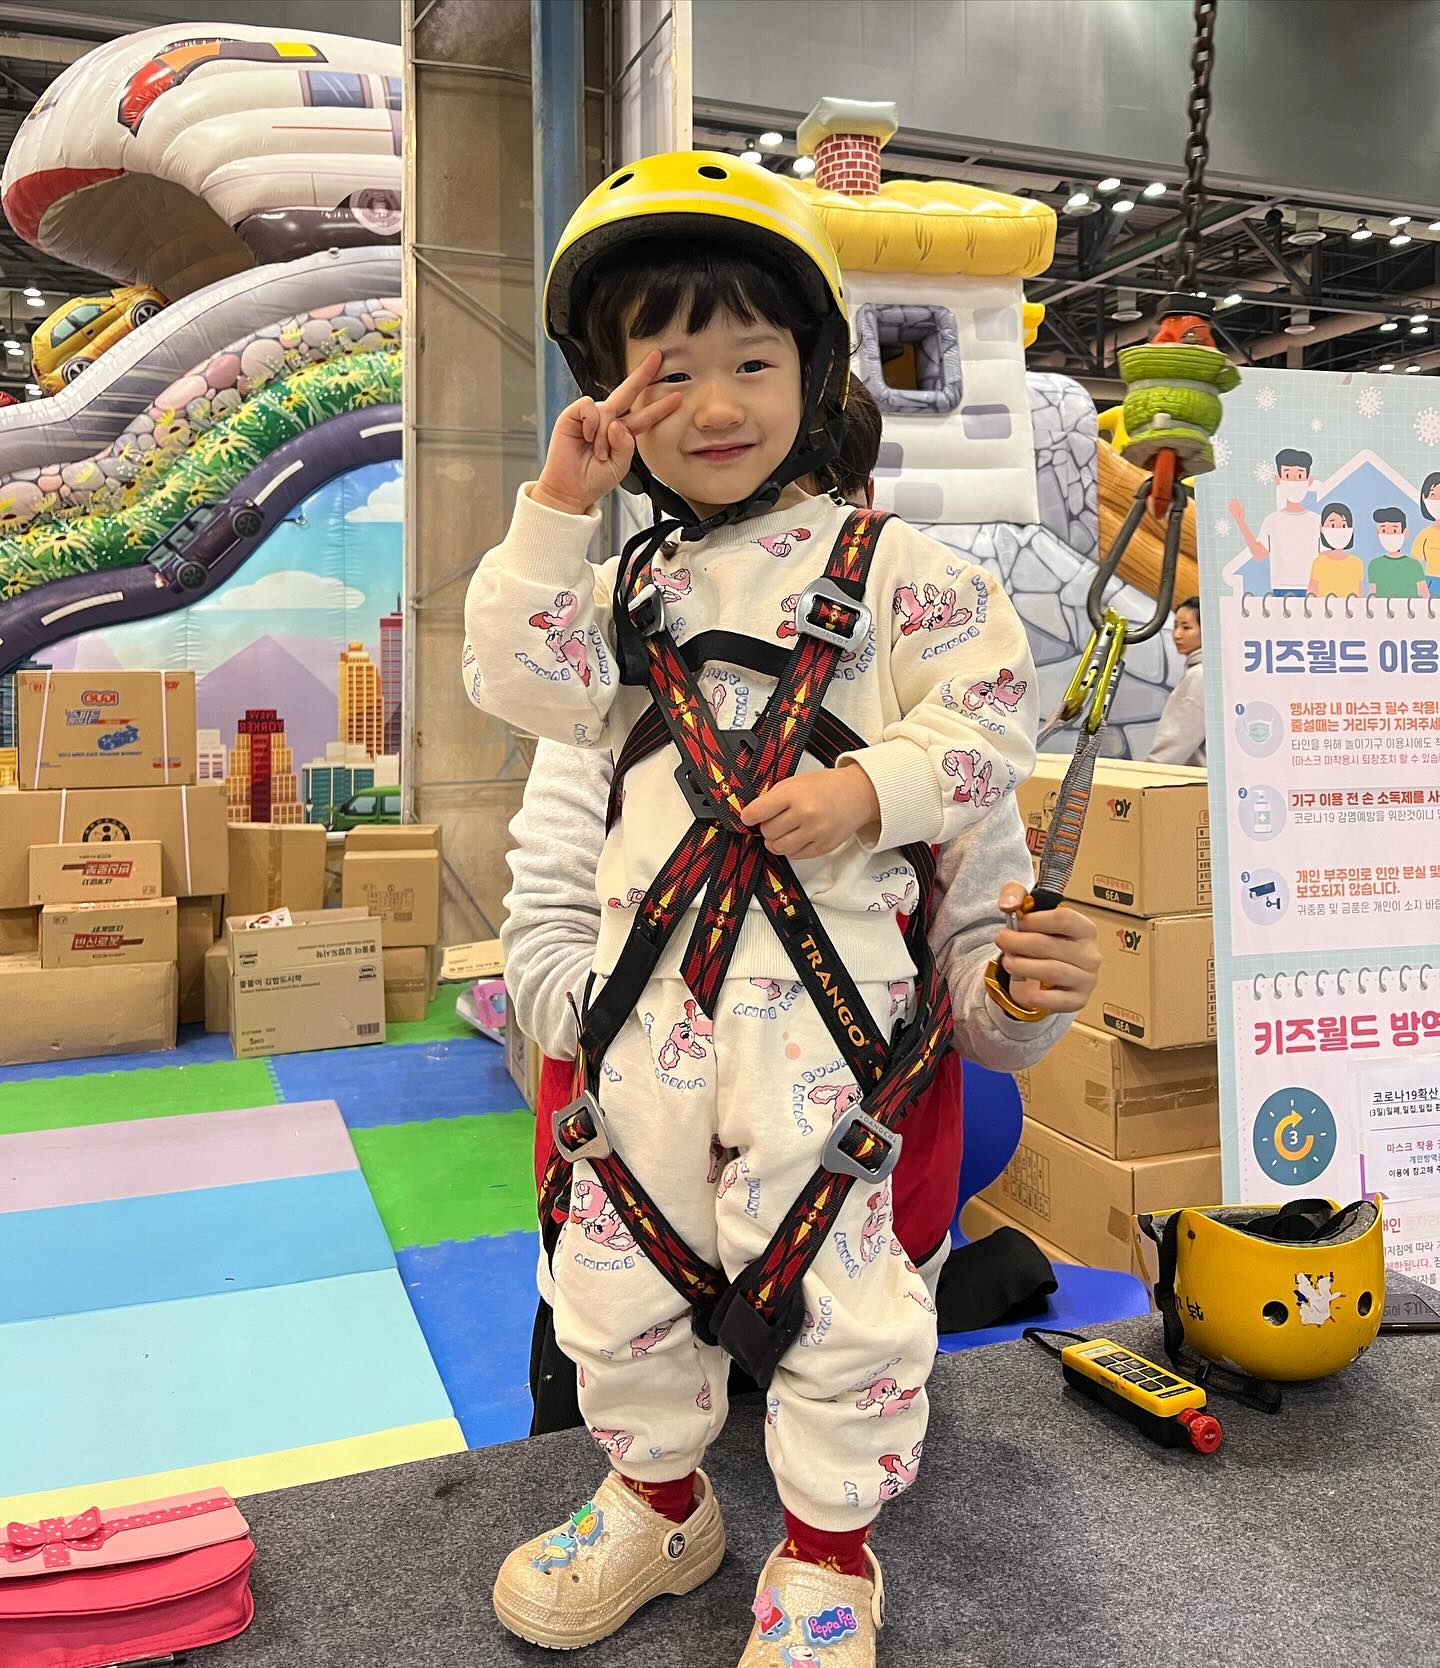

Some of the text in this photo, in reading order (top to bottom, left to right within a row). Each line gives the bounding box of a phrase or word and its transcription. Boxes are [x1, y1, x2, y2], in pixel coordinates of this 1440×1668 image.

[971, 575, 988, 623] LOVELY
[922, 626, 980, 660] BUNNY
[587, 624, 611, 686] BUNNY
[1244, 639, 1439, 674] 키즈월드 이용
[515, 652, 571, 681] BUNNY
[731, 687, 750, 730] BUNN
[1290, 701, 1439, 716] 행사장 내 마스크 필수 착용!
[1291, 719, 1339, 732] 줄설때는
[1343, 718, 1390, 732] 거리두기
[1323, 738, 1342, 750] 위해
[1386, 737, 1432, 749] 이용시에도
[1411, 753, 1419, 764] 수
[1292, 793, 1316, 807] 기구
[1319, 793, 1343, 806] 이용
[1347, 792, 1359, 805] 전
[1362, 792, 1374, 805] 손
[1377, 790, 1425, 804] 소독제를
[1294, 812, 1335, 824] 코로나19
[1296, 869, 1320, 883] 개인
[1324, 867, 1372, 882] 부주의로
[1376, 866, 1399, 881] 인한
[1105, 889, 1120, 902] 6EA
[1296, 881, 1400, 898] 보호되지 않습니다.
[1298, 903, 1326, 916] 귀중품
[1329, 902, 1338, 915] 및
[1373, 900, 1401, 913] 개인이
[1404, 899, 1422, 911] 소지
[800, 933, 866, 1048] TRANGO
[1254, 1015, 1381, 1056] 키즈월드
[1372, 1087, 1439, 1103] 코로나19확산
[792, 1083, 814, 1137] LOVELY
[1289, 1130, 1298, 1145] 3
[1386, 1142, 1413, 1154] 마스크
[1384, 1241, 1434, 1256] 지침에 따라
[575, 1252, 635, 1271] BUNNY
[810, 1609, 856, 1637] Peppa Pig
